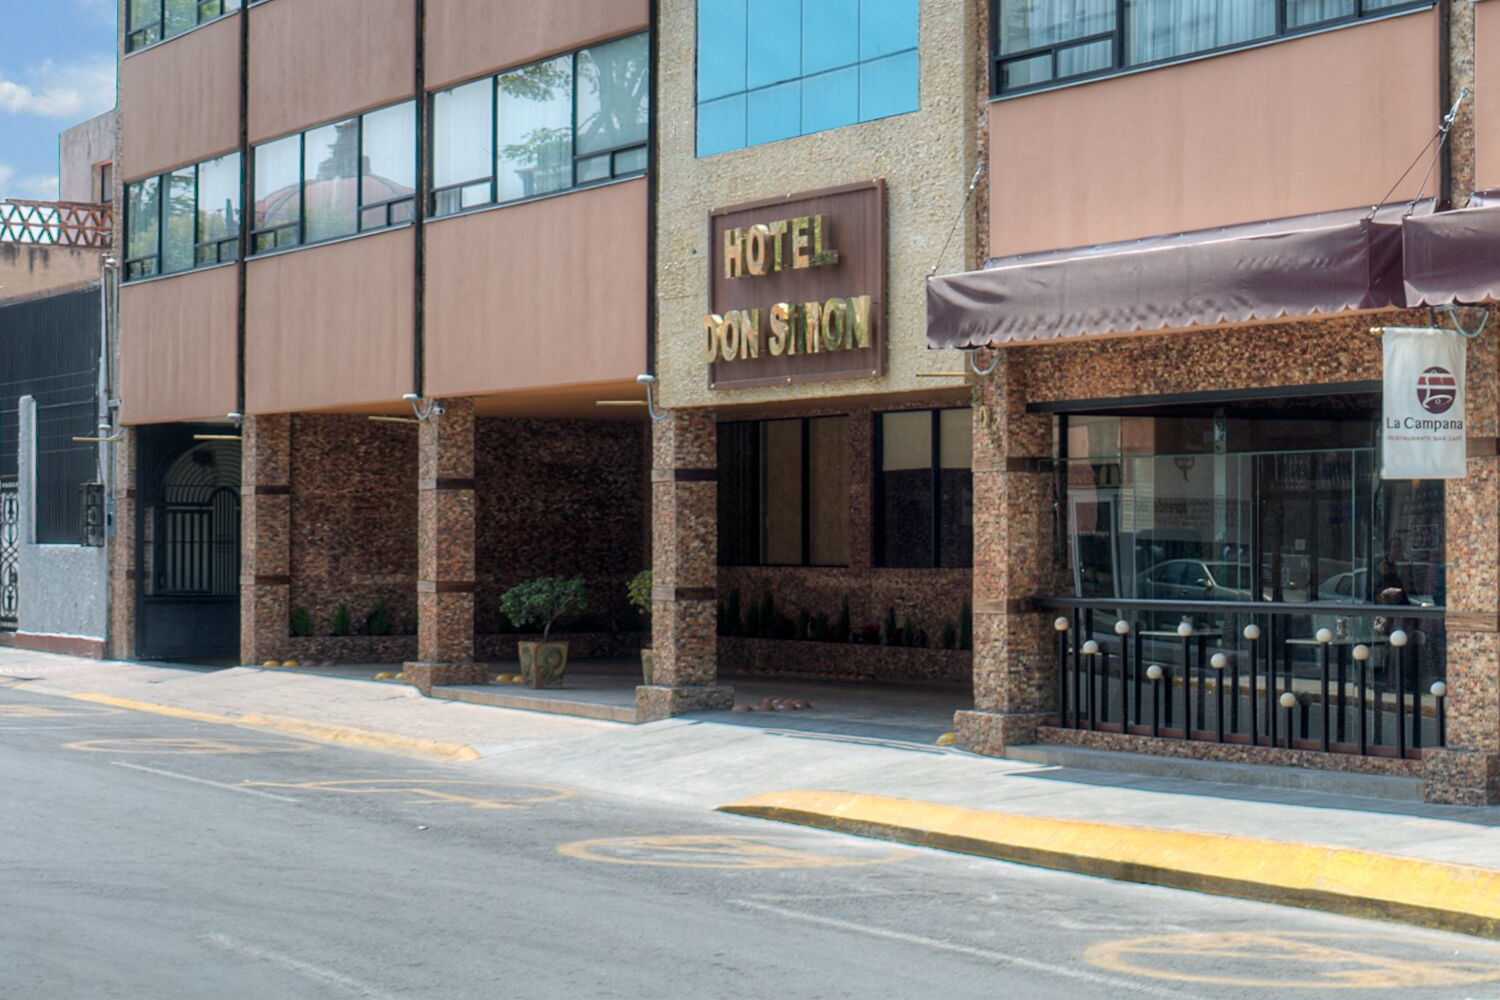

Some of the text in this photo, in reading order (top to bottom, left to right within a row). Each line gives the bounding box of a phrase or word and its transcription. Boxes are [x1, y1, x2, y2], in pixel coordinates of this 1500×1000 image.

[724, 215, 839, 279] HOTEL
[703, 295, 872, 363] DON SIMON
[1386, 417, 1463, 432] La Campana
